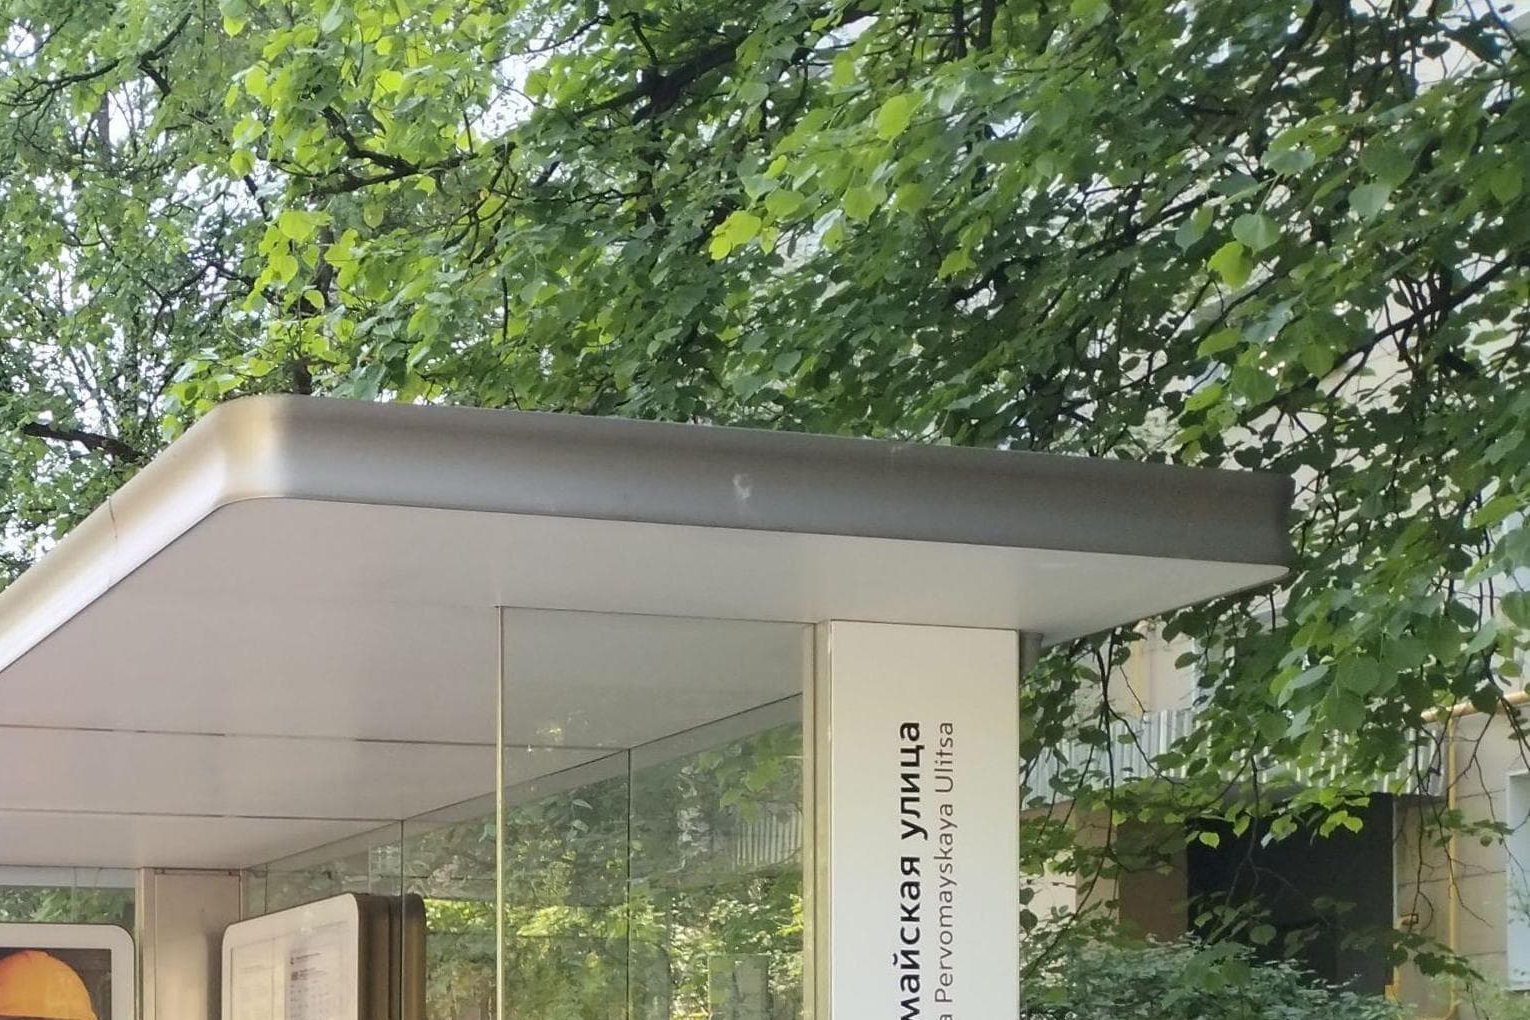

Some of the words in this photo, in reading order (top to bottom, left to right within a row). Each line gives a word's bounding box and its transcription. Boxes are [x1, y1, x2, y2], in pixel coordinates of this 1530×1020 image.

[900, 722, 928, 841] улица
[934, 722, 953, 793] Ulitsa
[934, 804, 957, 1002] Pervomayskaya
